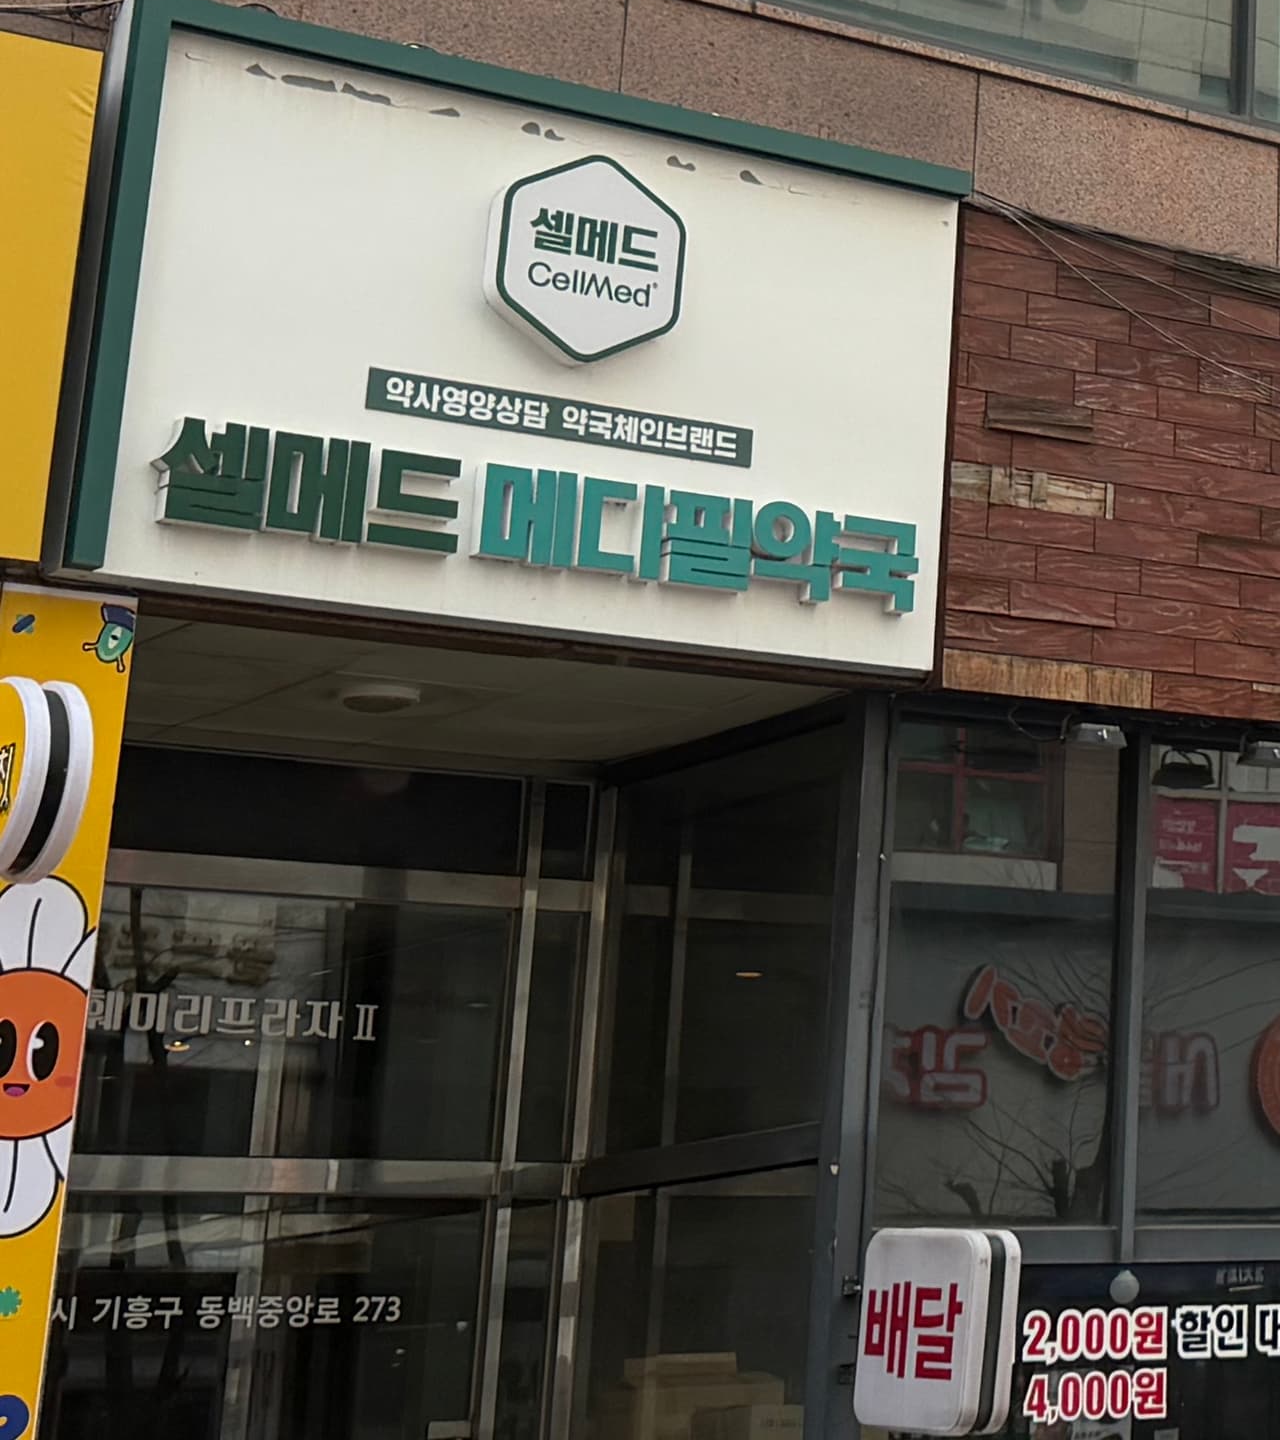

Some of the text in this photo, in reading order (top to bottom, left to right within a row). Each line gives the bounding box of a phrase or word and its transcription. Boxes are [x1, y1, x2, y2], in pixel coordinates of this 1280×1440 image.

[529, 206, 660, 273] 셀메드
[385, 375, 738, 459] 약사영양상담 약국체인브랜드
[152, 417, 919, 614] 셀메드 메디필약국
[91, 1293, 185, 1330] 기흥구
[196, 1292, 342, 1328] 동백중앙로
[352, 1293, 402, 1324] 273
[863, 1280, 964, 1382] 배달
[1023, 1305, 1169, 1365] 2,000원
[1175, 1301, 1249, 1358] 할인
[1022, 1367, 1168, 1425] 4,000원
